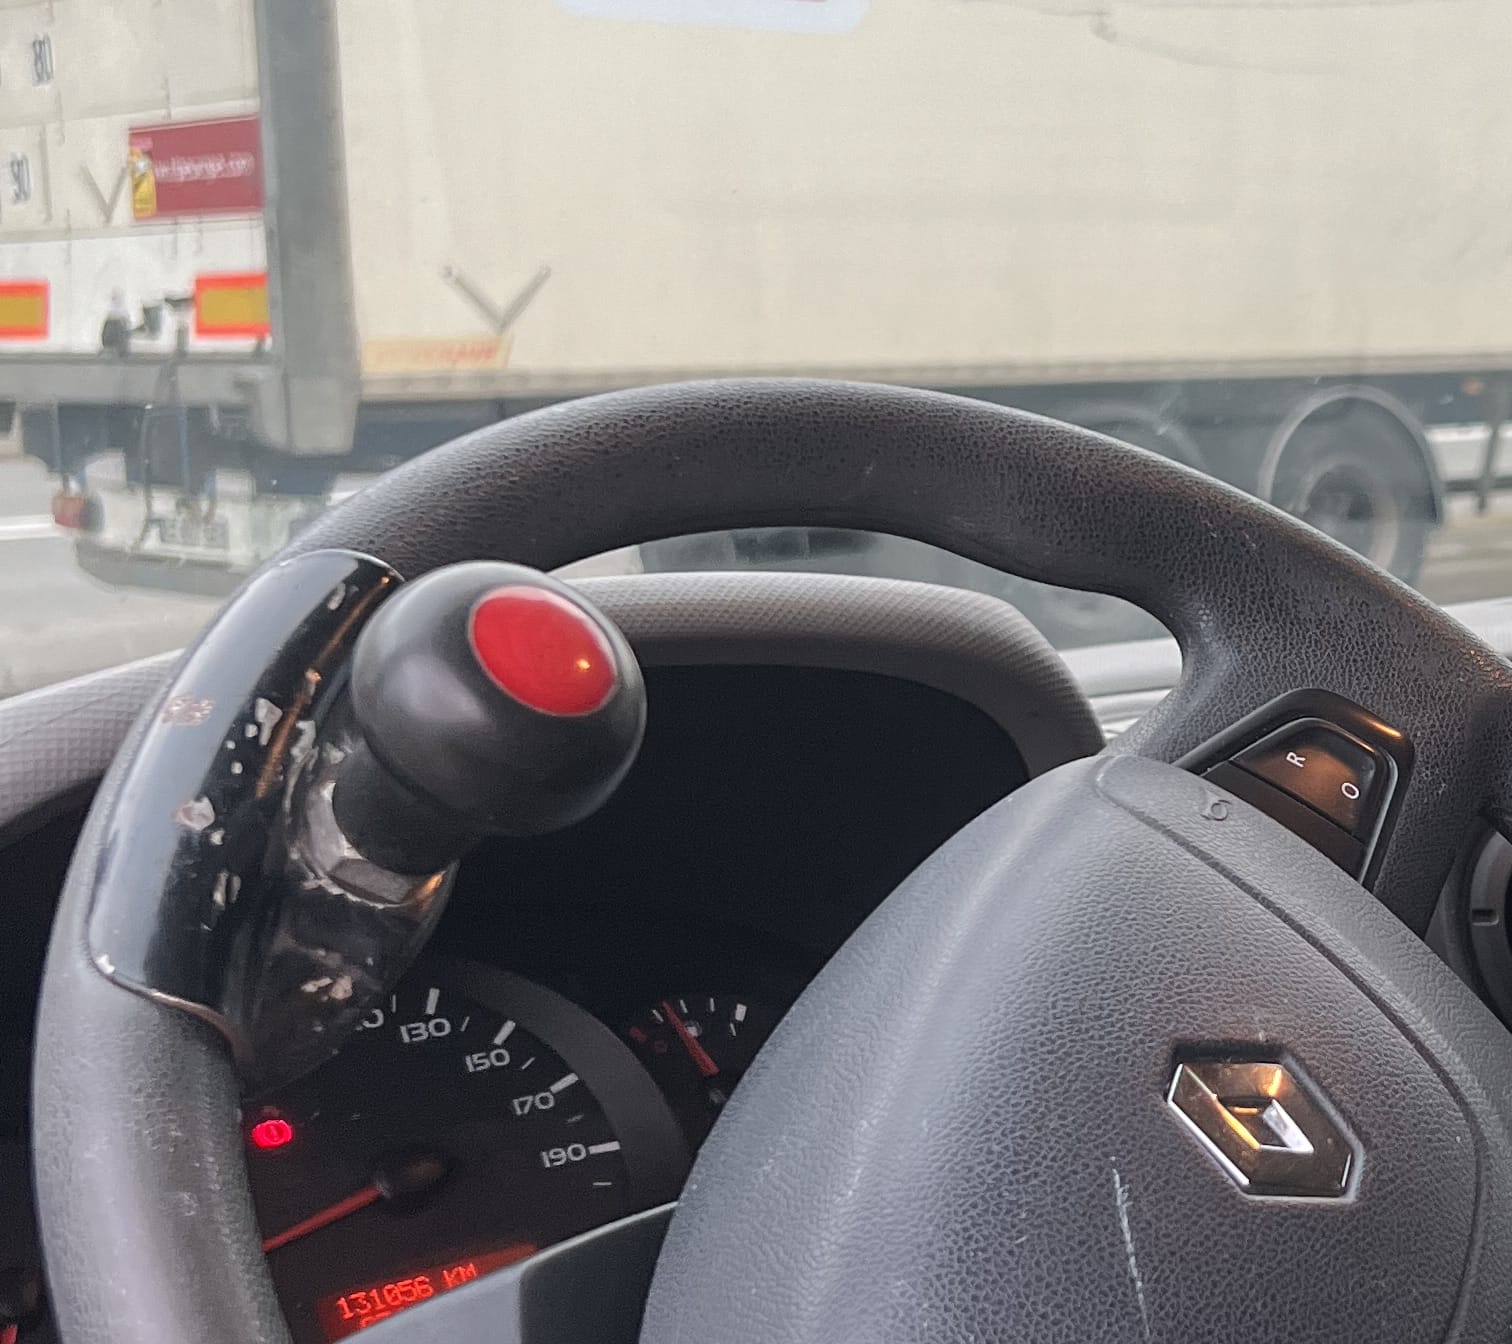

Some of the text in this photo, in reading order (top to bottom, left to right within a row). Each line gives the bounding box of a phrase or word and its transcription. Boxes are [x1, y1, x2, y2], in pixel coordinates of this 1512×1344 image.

[1286, 751, 1306, 768] R
[399, 1017, 452, 1044] 130
[464, 1047, 511, 1073] 150
[512, 1090, 556, 1116] 170
[541, 1142, 588, 1168] 190
[336, 1275, 435, 1321] 131056
[442, 1262, 478, 1290] KM
